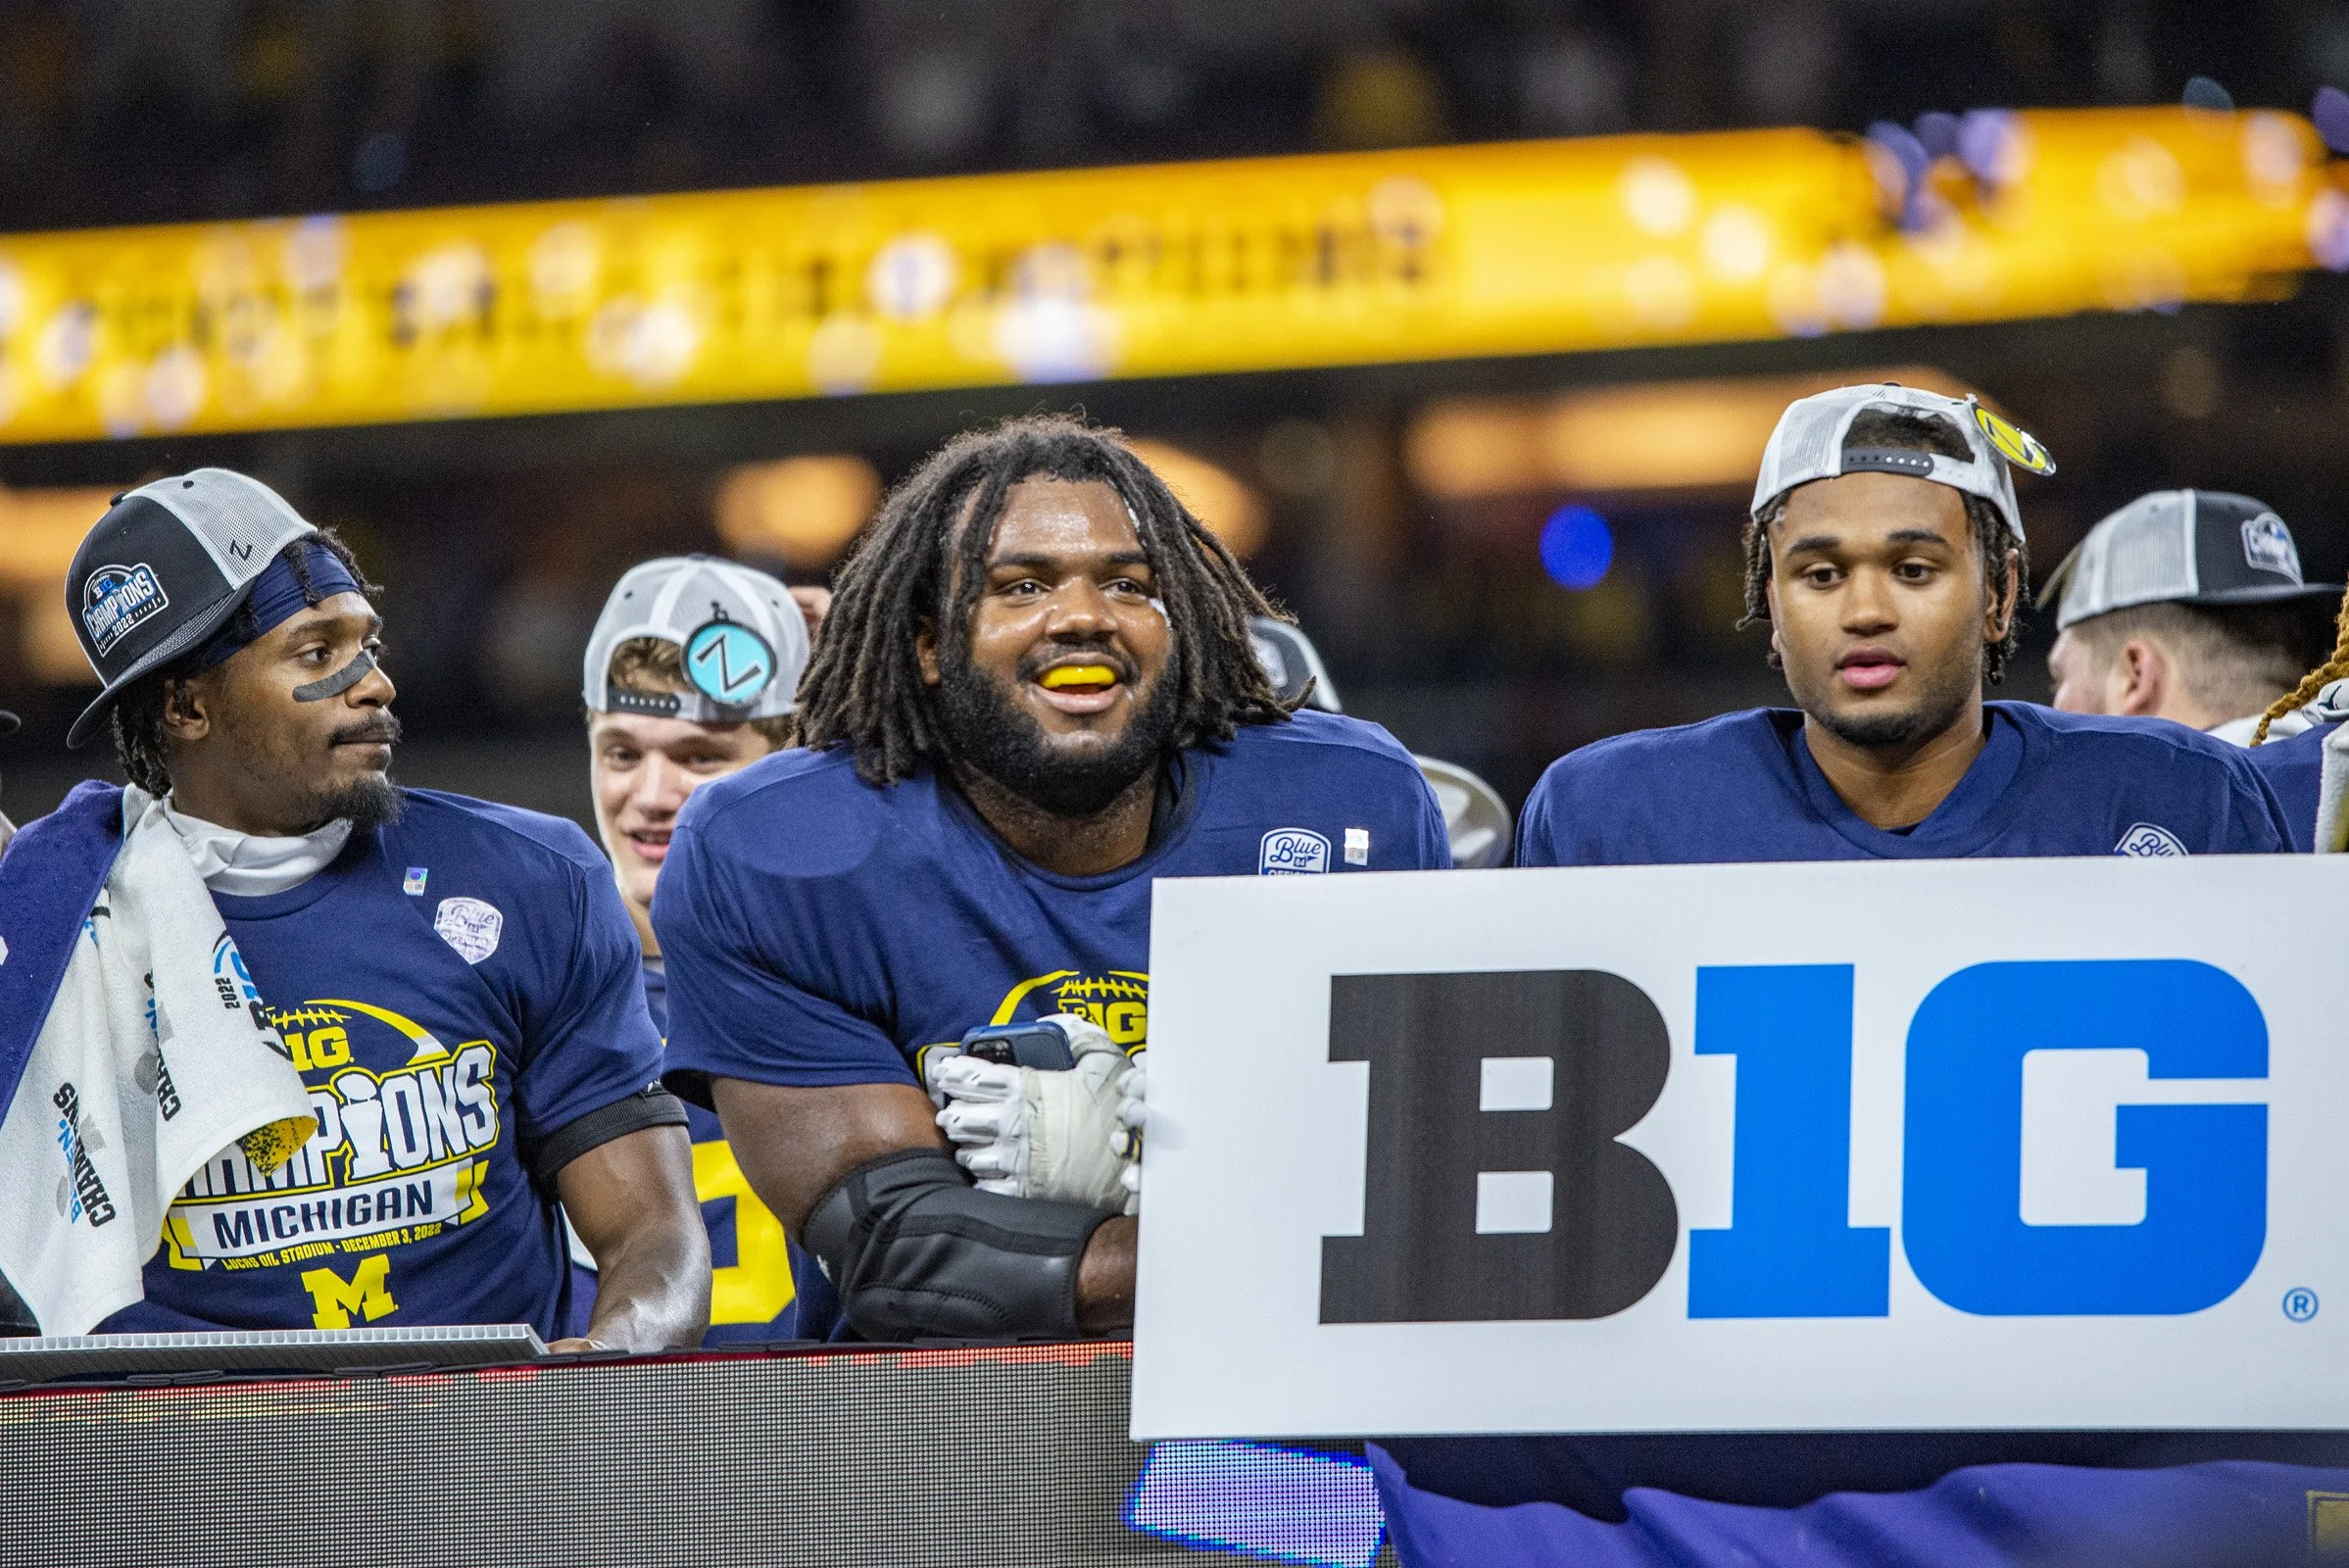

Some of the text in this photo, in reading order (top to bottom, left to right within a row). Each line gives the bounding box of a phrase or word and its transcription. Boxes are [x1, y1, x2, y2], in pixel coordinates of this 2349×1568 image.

[86, 570, 154, 639] CHAMPIONS
[112, 613, 135, 637] 2022
[1269, 836, 1322, 862] Blue
[215, 977, 241, 1009] 2022
[212, 1180, 432, 1250] MICHIGAN
[221, 1256, 260, 1270] LUCAS
[259, 1252, 280, 1267] OIL
[280, 1242, 335, 1264] STADIUM
[341, 1231, 401, 1252] DECEMBER
[414, 1222, 442, 1241] 2022
[301, 1253, 395, 1330] M
